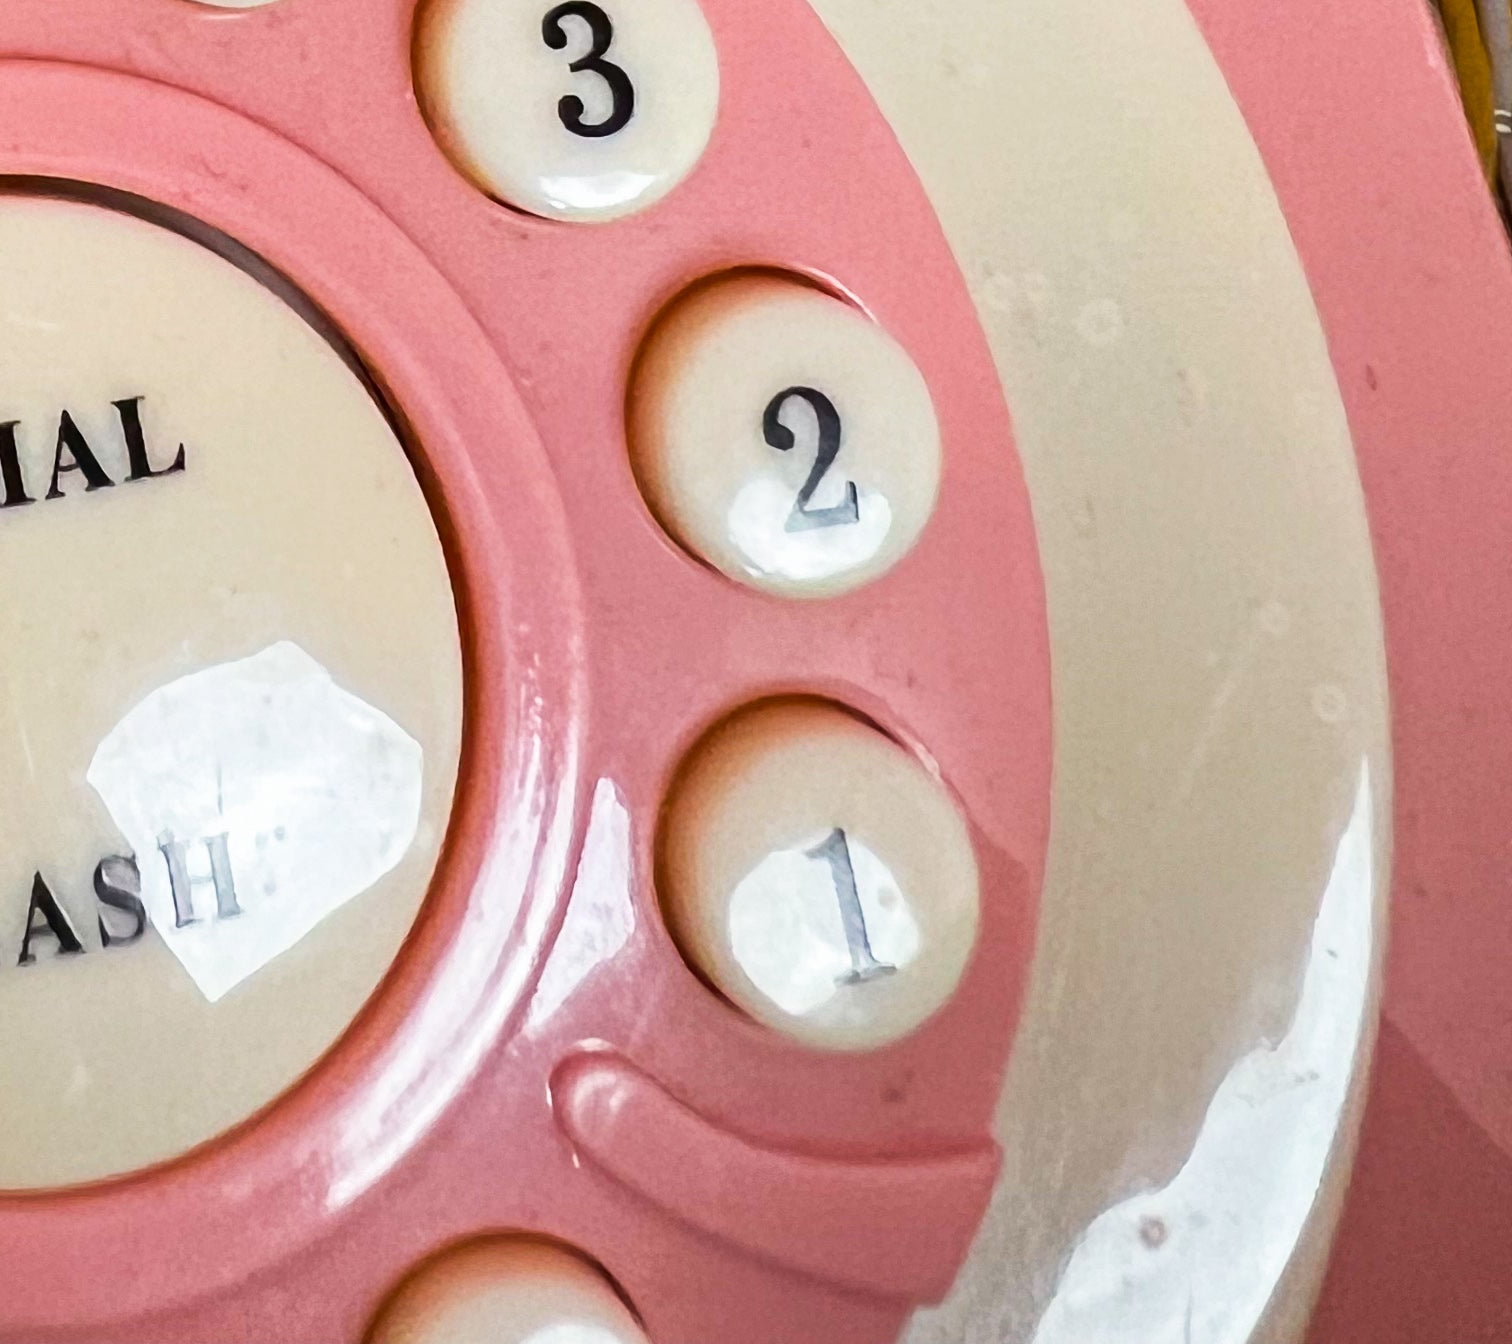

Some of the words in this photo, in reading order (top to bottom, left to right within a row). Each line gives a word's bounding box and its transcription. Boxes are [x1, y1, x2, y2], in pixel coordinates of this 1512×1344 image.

[542, 0, 635, 138] 3
[761, 386, 859, 583] 2
[804, 827, 898, 988] 1
